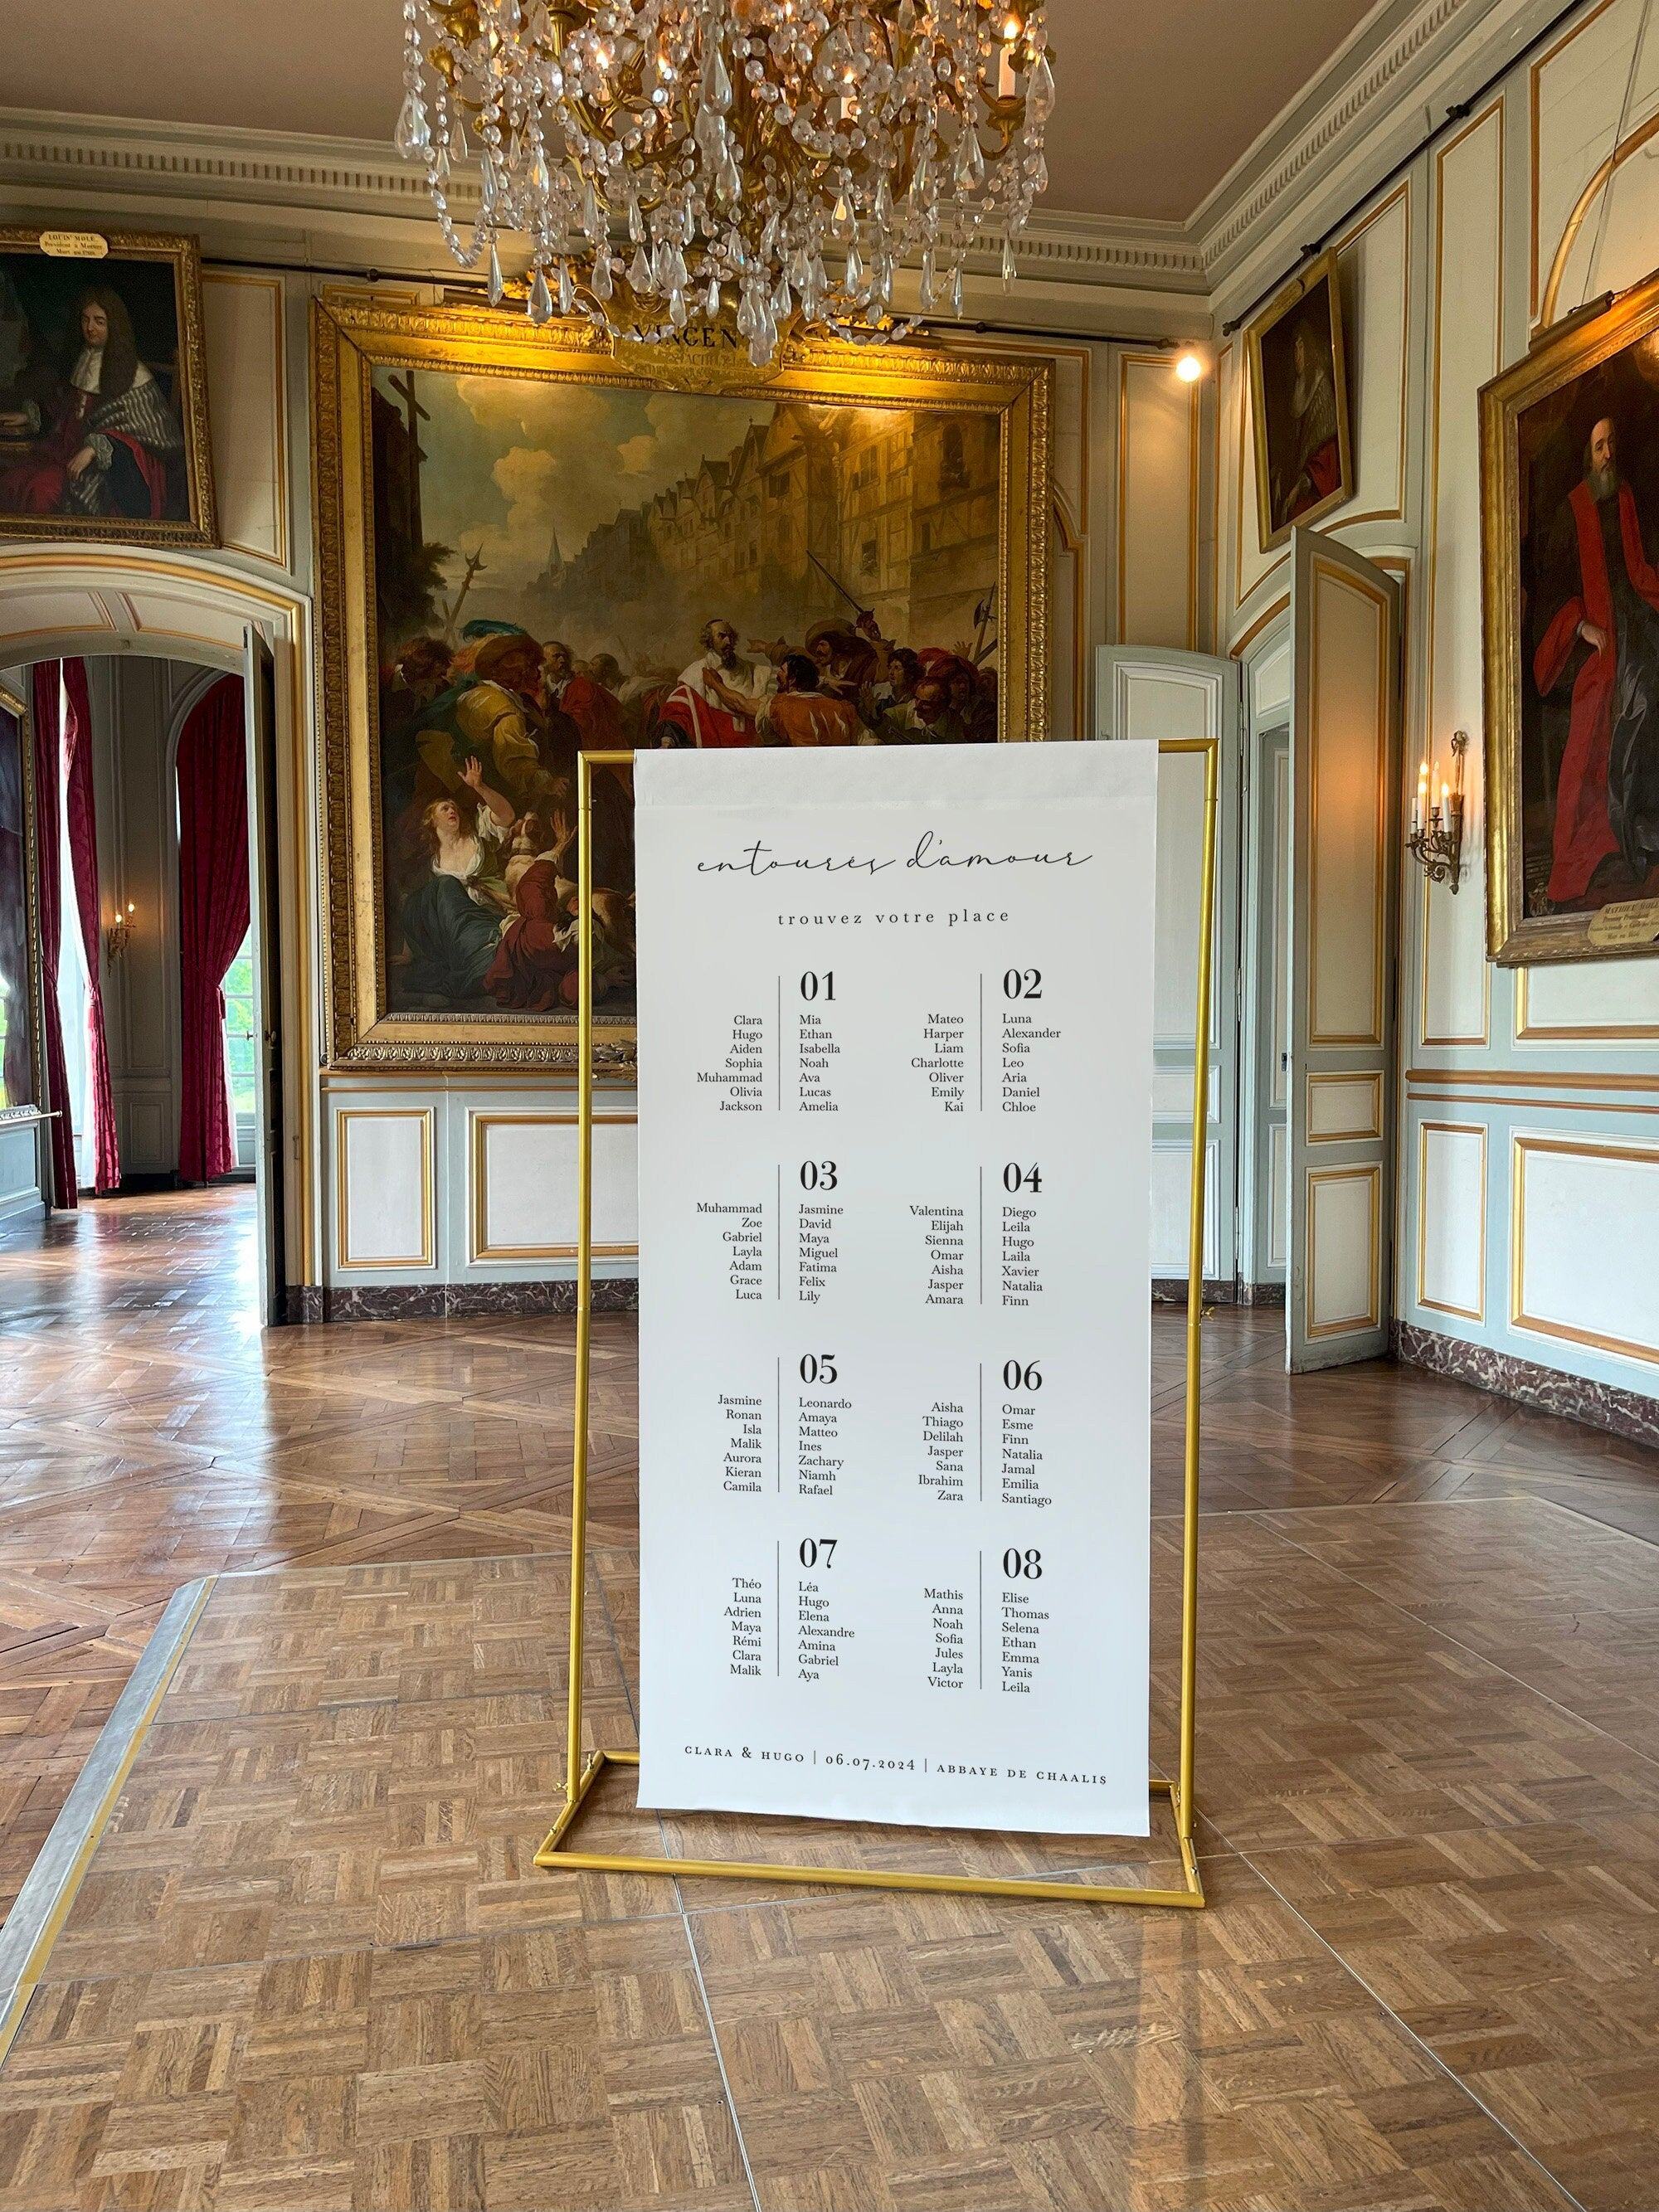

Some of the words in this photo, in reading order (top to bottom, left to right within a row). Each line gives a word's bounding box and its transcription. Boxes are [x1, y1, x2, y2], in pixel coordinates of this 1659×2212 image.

[633, 323, 752, 348] VINCEN
[697, 839, 897, 877] entourés
[906, 830, 1093, 869] d'amour
[778, 915, 862, 926] trouvez
[875, 912, 934, 924] votre
[948, 908, 1009, 927] place
[800, 970, 836, 1002] 01
[1003, 968, 1043, 1000] 02
[733, 1014, 763, 1026] Clara
[799, 1014, 822, 1025] Mia
[927, 1013, 964, 1024] Mateo
[1002, 1013, 1032, 1024] Luna
[732, 1028, 763, 1043] Hugo
[799, 1028, 833, 1039] Ethan
[923, 1028, 965, 1043] Harper
[1001, 1027, 1062, 1038] Alexander
[729, 1043, 763, 1054] Aiden
[799, 1043, 841, 1054] Isabella
[934, 1043, 964, 1053] Liam
[1001, 1042, 1030, 1053] Sofia
[725, 1057, 763, 1072] Sophia
[799, 1057, 830, 1068] Noah
[911, 1057, 964, 1068] Charlotte
[1002, 1057, 1024, 1068] Leo
[696, 1072, 763, 1083] Muhammad
[798, 1072, 821, 1082] Ava
[928, 1072, 965, 1083] Oliver
[1001, 1072, 1028, 1083] Aria
[729, 1086, 763, 1097] Olivia
[799, 1087, 832, 1097] Lucas
[931, 1087, 965, 1101] Emily
[1002, 1087, 1040, 1098] Daniel
[719, 1101, 763, 1111] Jackson
[798, 1101, 839, 1111] Amelia
[944, 1101, 964, 1112] Kai
[1002, 1101, 1036, 1112] Chloe
[800, 1160, 838, 1191] 03
[1003, 1162, 1043, 1194] 04
[696, 1202, 763, 1214] Muhammad
[798, 1203, 844, 1215] Jasmine
[909, 1205, 964, 1217] Valentina
[1002, 1206, 1037, 1221] Diego
[742, 1217, 763, 1228] Zoe
[799, 1218, 832, 1229] David
[931, 1220, 964, 1235] Elijah
[1002, 1221, 1031, 1232] Leila
[722, 1231, 762, 1242] Gabriel
[799, 1232, 830, 1247] Maya
[925, 1234, 964, 1247] Sienna
[1002, 1236, 1035, 1251] Hugo
[732, 1246, 763, 1260] Layla
[799, 1247, 839, 1262] Miguel
[930, 1249, 965, 1261] Omar
[1002, 1251, 1031, 1262] Laila
[728, 1260, 762, 1271] Adam
[799, 1261, 838, 1273] Fatima
[931, 1264, 964, 1276] Aisha
[1001, 1265, 1040, 1277] Xavier
[729, 1274, 762, 1286] Grace
[799, 1276, 826, 1287] Felix
[927, 1278, 964, 1293] Jasper
[1002, 1280, 1044, 1292] Natalia
[735, 1288, 763, 1300] Luca
[799, 1290, 821, 1305] Lily
[924, 1293, 964, 1305] Amara
[1001, 1295, 1029, 1306] Finn
[799, 1353, 838, 1385] 05
[1003, 1359, 1043, 1392] 06
[718, 1393, 762, 1406] Jasmine
[798, 1397, 853, 1409] Leonardo
[931, 1402, 964, 1413] Aisha
[1001, 1403, 1036, 1416] Omar
[726, 1408, 762, 1421] Ronan
[798, 1412, 838, 1427] Amaya
[742, 1423, 762, 1435] Isla
[922, 1416, 964, 1431] Thiago
[1002, 1418, 1034, 1431] Esme
[799, 1426, 839, 1438] Matteo
[922, 1430, 964, 1442] Delilah
[730, 1437, 762, 1449] Malik
[1001, 1432, 1029, 1445] Finn
[798, 1440, 822, 1452] Ines
[722, 1451, 762, 1464] Aurora
[927, 1445, 964, 1460] Jasper
[1001, 1447, 1044, 1461] Natalia
[798, 1454, 844, 1471] Zachary
[936, 1460, 964, 1472] Sana
[1001, 1462, 1035, 1475] Jamal
[725, 1466, 762, 1478] Kieran
[798, 1469, 837, 1481] Niamh
[722, 1480, 762, 1493] Camila
[917, 1474, 964, 1487] Ibrahim
[1001, 1477, 1039, 1490] Emilia
[798, 1483, 834, 1495] Rafael
[937, 1490, 964, 1501] Zara
[1001, 1492, 1053, 1509] Santiago
[799, 1538, 839, 1569] 07
[1002, 1548, 1043, 1580] 08
[732, 1577, 762, 1590] Théo
[798, 1581, 820, 1592] Léa
[733, 1592, 762, 1604] Luna
[923, 1587, 964, 1601] Mathis
[1001, 1592, 1029, 1604] Elise
[798, 1595, 830, 1611] Hugo
[931, 1602, 964, 1616] Anna
[723, 1606, 761, 1618] Adrien
[798, 1610, 830, 1622] Elena
[1000, 1606, 1050, 1620] Thomas
[731, 1620, 762, 1636] Maya
[932, 1617, 964, 1630] Noah
[1001, 1621, 1039, 1635] Selena
[797, 1625, 855, 1638] Alexandre
[732, 1635, 762, 1647] Rémi
[935, 1632, 964, 1645] Sofia
[1001, 1636, 1037, 1649] Ethan
[797, 1639, 836, 1652] Amina
[732, 1649, 762, 1661] Clara
[935, 1646, 964, 1660] Jules
[1001, 1650, 1040, 1665] Emma
[798, 1653, 839, 1666] Gabriel
[729, 1663, 762, 1676] Malik
[932, 1661, 964, 1677] Layla
[1000, 1665, 1033, 1679] Yanis
[797, 1668, 820, 1683] Aya
[927, 1675, 964, 1689] Victor
[1001, 1680, 1031, 1694] Leila
[684, 1745, 732, 1757] CLARA
[742, 1746, 752, 1759] &
[761, 1751, 805, 1762] HUGO
[825, 1753, 915, 1772] 06.07.2024
[937, 1764, 998, 1777] ABBAYE
[1007, 1768, 1027, 1779] DE
[1036, 1771, 1107, 1786] CHAALIS
